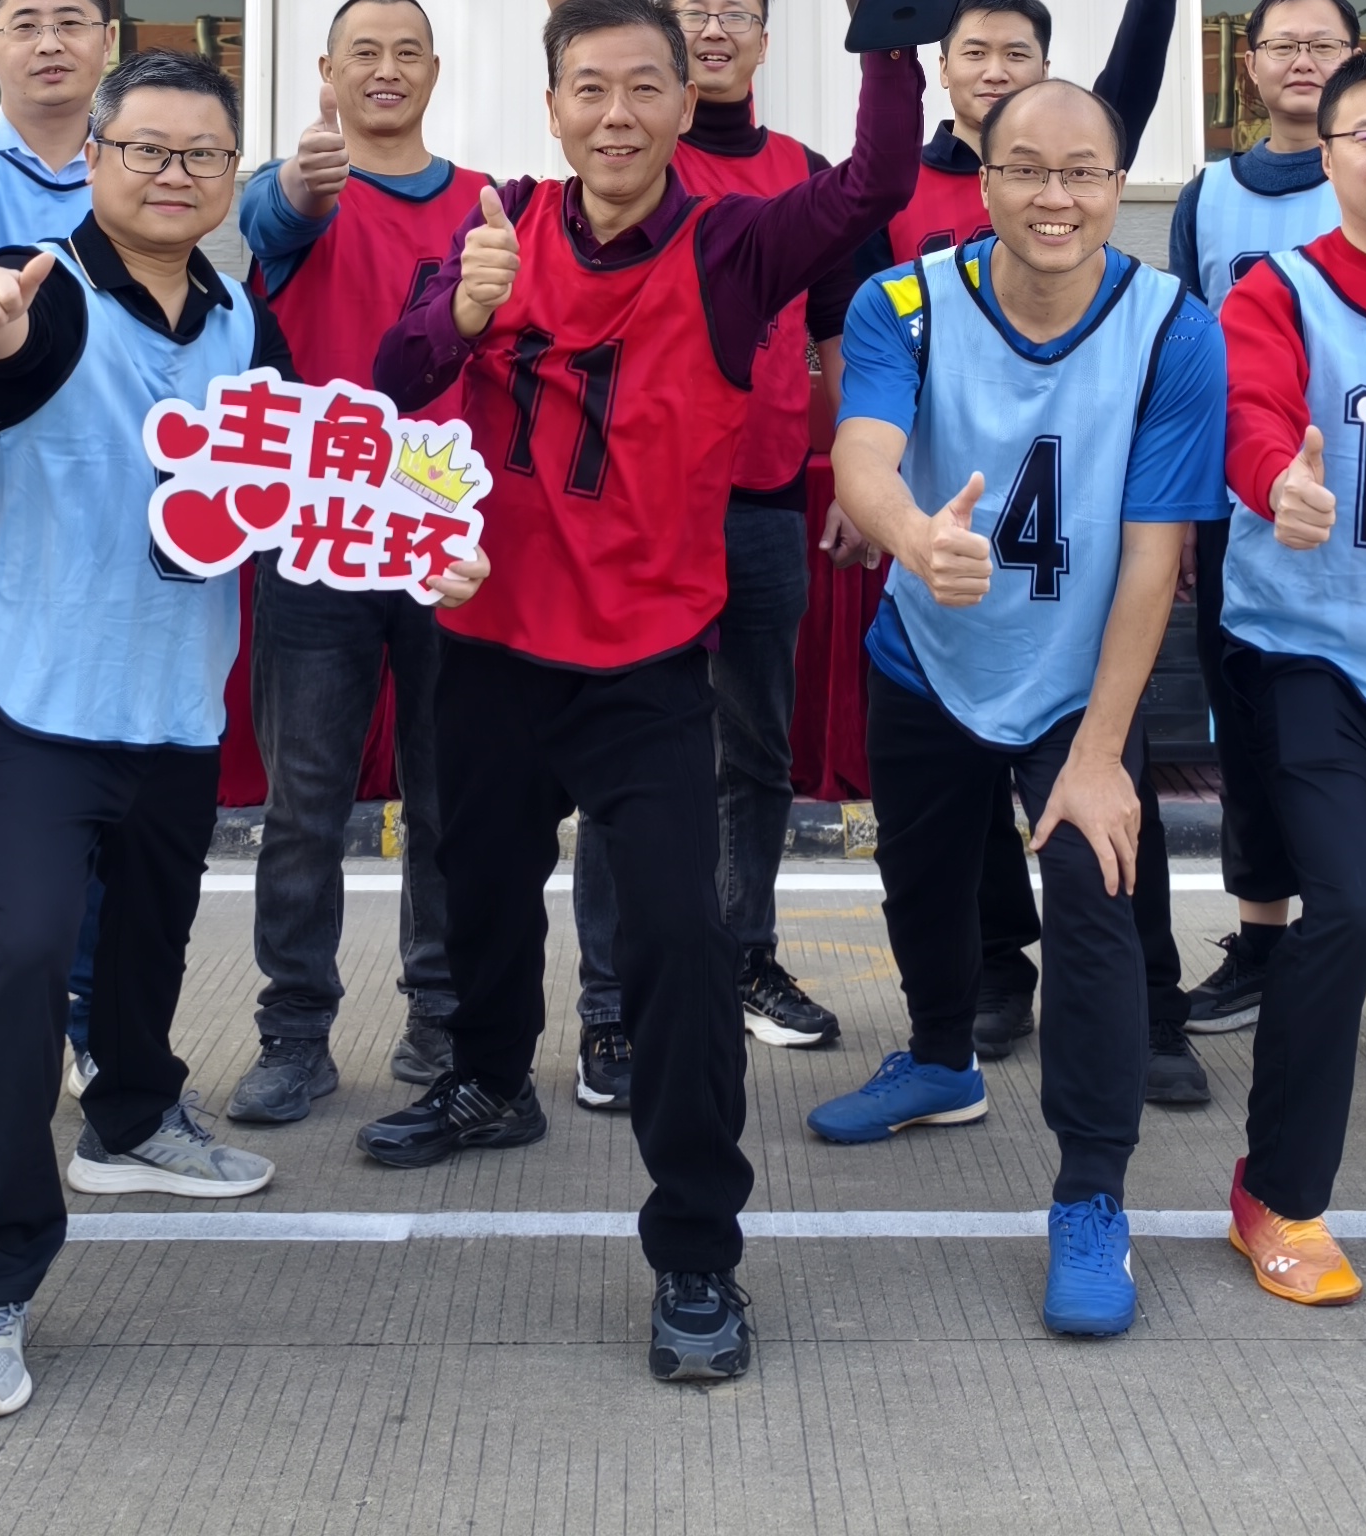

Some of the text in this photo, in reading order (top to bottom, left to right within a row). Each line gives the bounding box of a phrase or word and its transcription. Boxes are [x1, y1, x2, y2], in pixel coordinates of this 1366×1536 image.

[210, 381, 393, 489] 主角
[503, 325, 623, 501] 11
[291, 496, 471, 592] 光环
[991, 434, 1070, 601] 4
